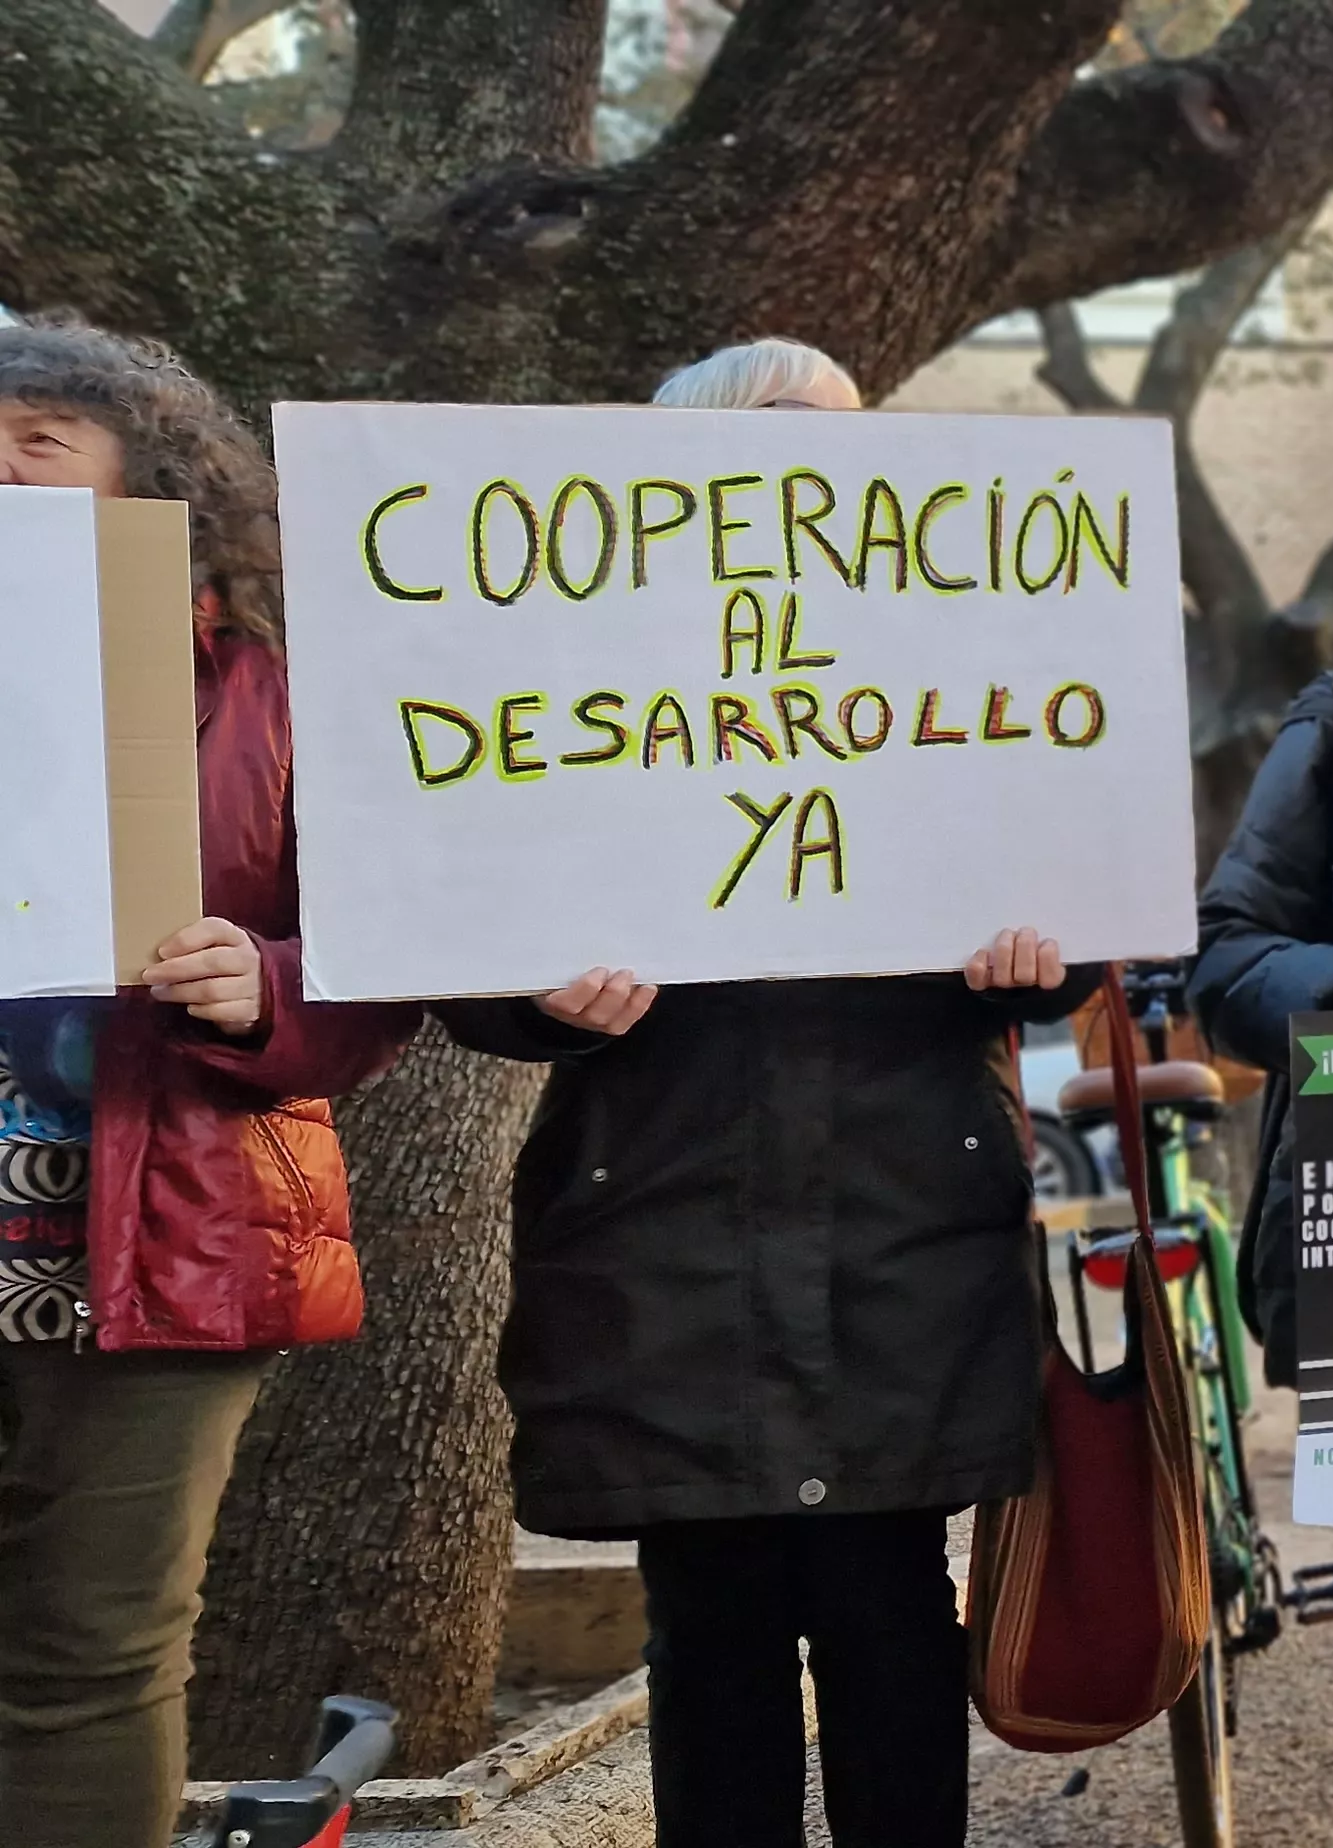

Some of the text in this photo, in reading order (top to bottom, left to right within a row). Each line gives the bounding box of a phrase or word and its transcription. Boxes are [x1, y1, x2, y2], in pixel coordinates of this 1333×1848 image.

[361, 468, 1132, 605] COOPERACIÓN
[720, 587, 836, 678] AL
[400, 681, 1106, 787] DESARROLLO
[708, 787, 846, 908] YA
